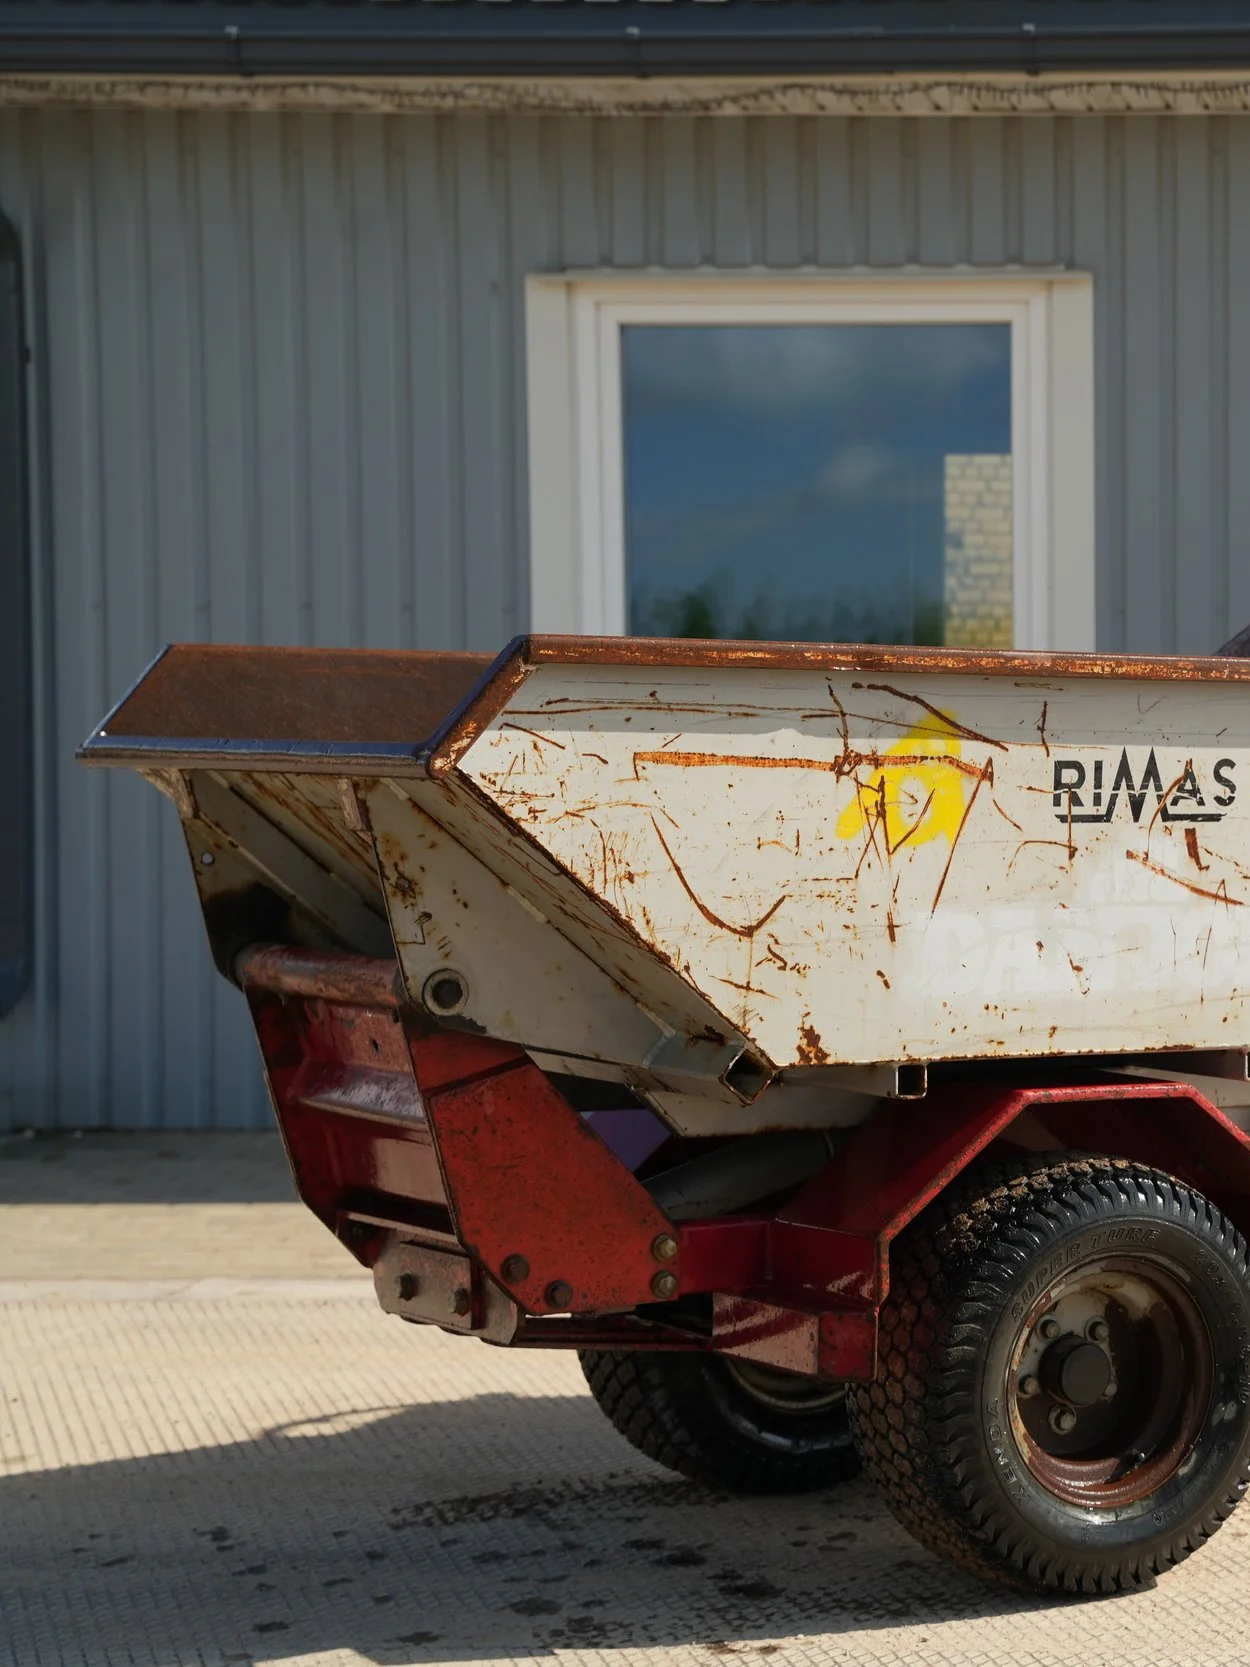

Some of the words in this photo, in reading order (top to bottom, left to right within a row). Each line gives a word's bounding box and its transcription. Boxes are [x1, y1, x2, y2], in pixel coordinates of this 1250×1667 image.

[1052, 746, 1237, 823] RIMAS
[1010, 1240, 1082, 1322] SUPER
[1090, 1227, 1162, 1249] TURF
[987, 1397, 1032, 1503] KENDA
